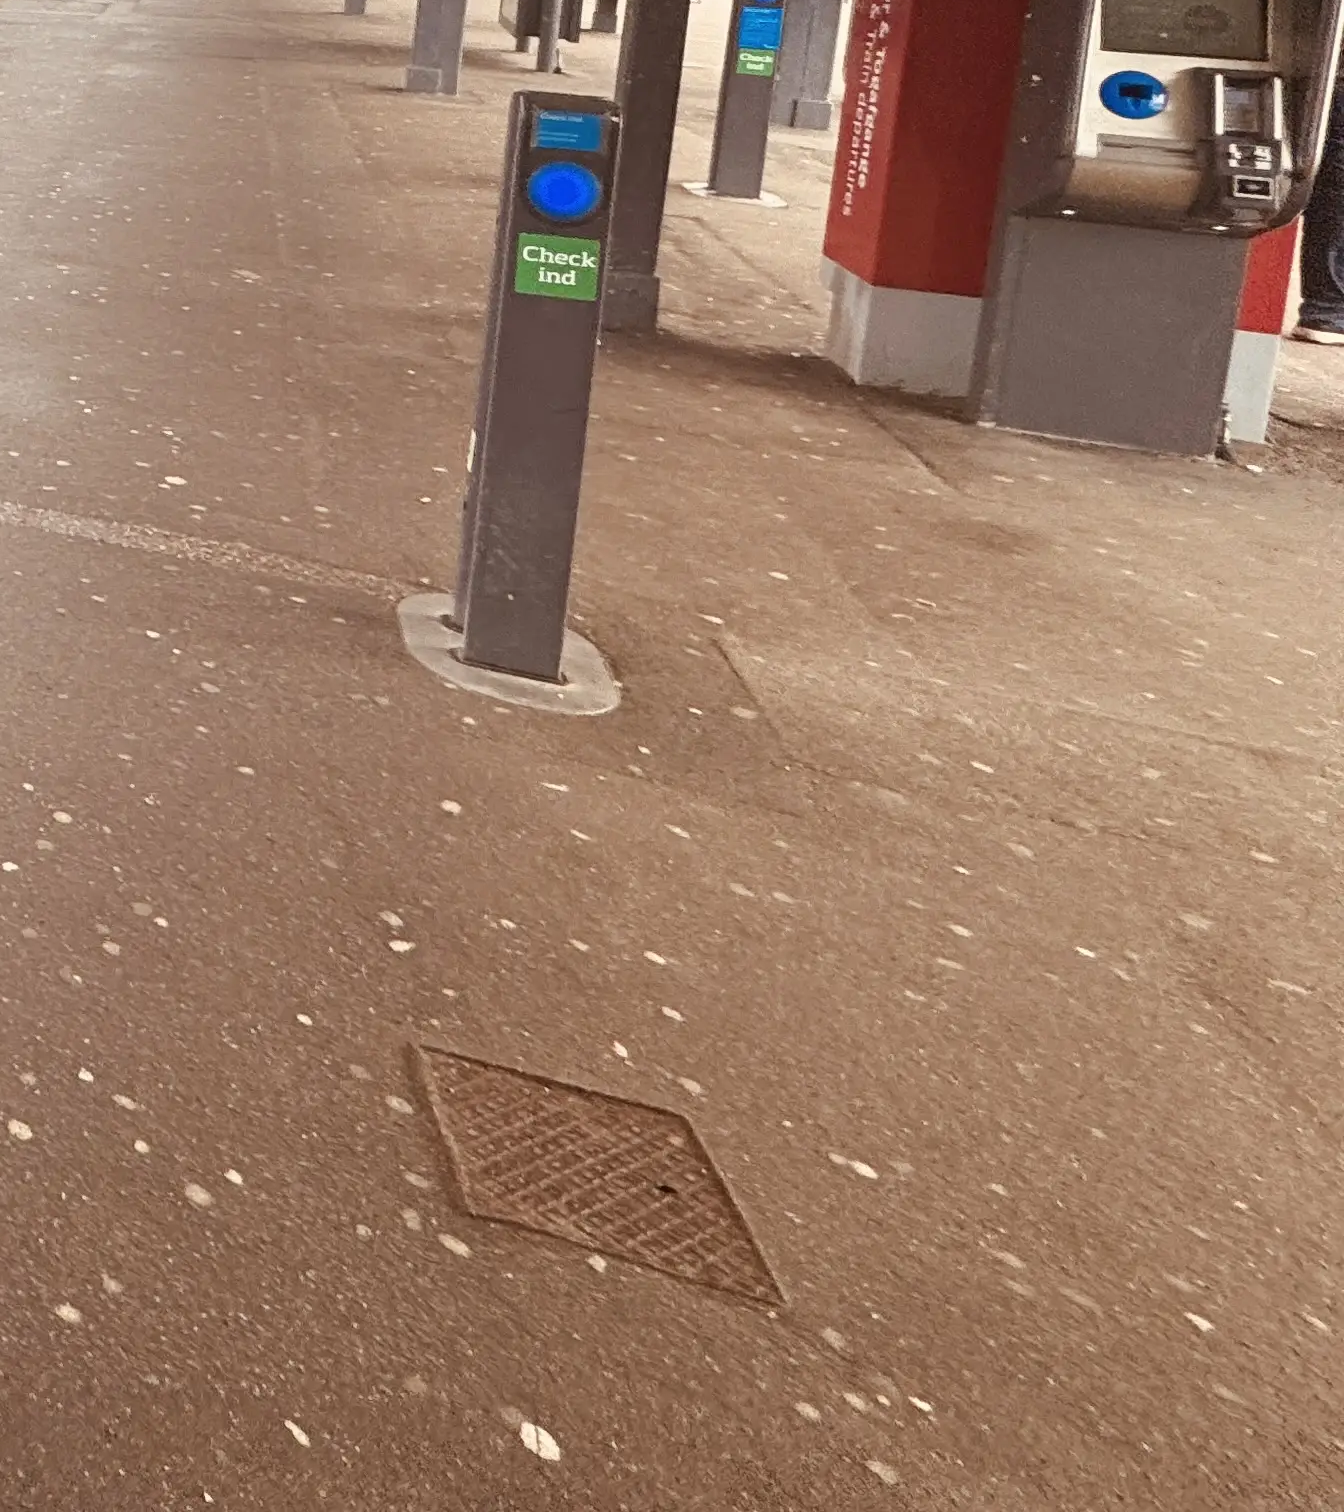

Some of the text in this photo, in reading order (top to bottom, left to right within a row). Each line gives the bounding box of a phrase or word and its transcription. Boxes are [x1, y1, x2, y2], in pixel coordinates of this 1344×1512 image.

[740, 52, 774, 63] Check
[859, 29, 879, 84] Train
[841, 92, 868, 217] departures
[522, 245, 598, 268] Check
[538, 266, 576, 286] ind
